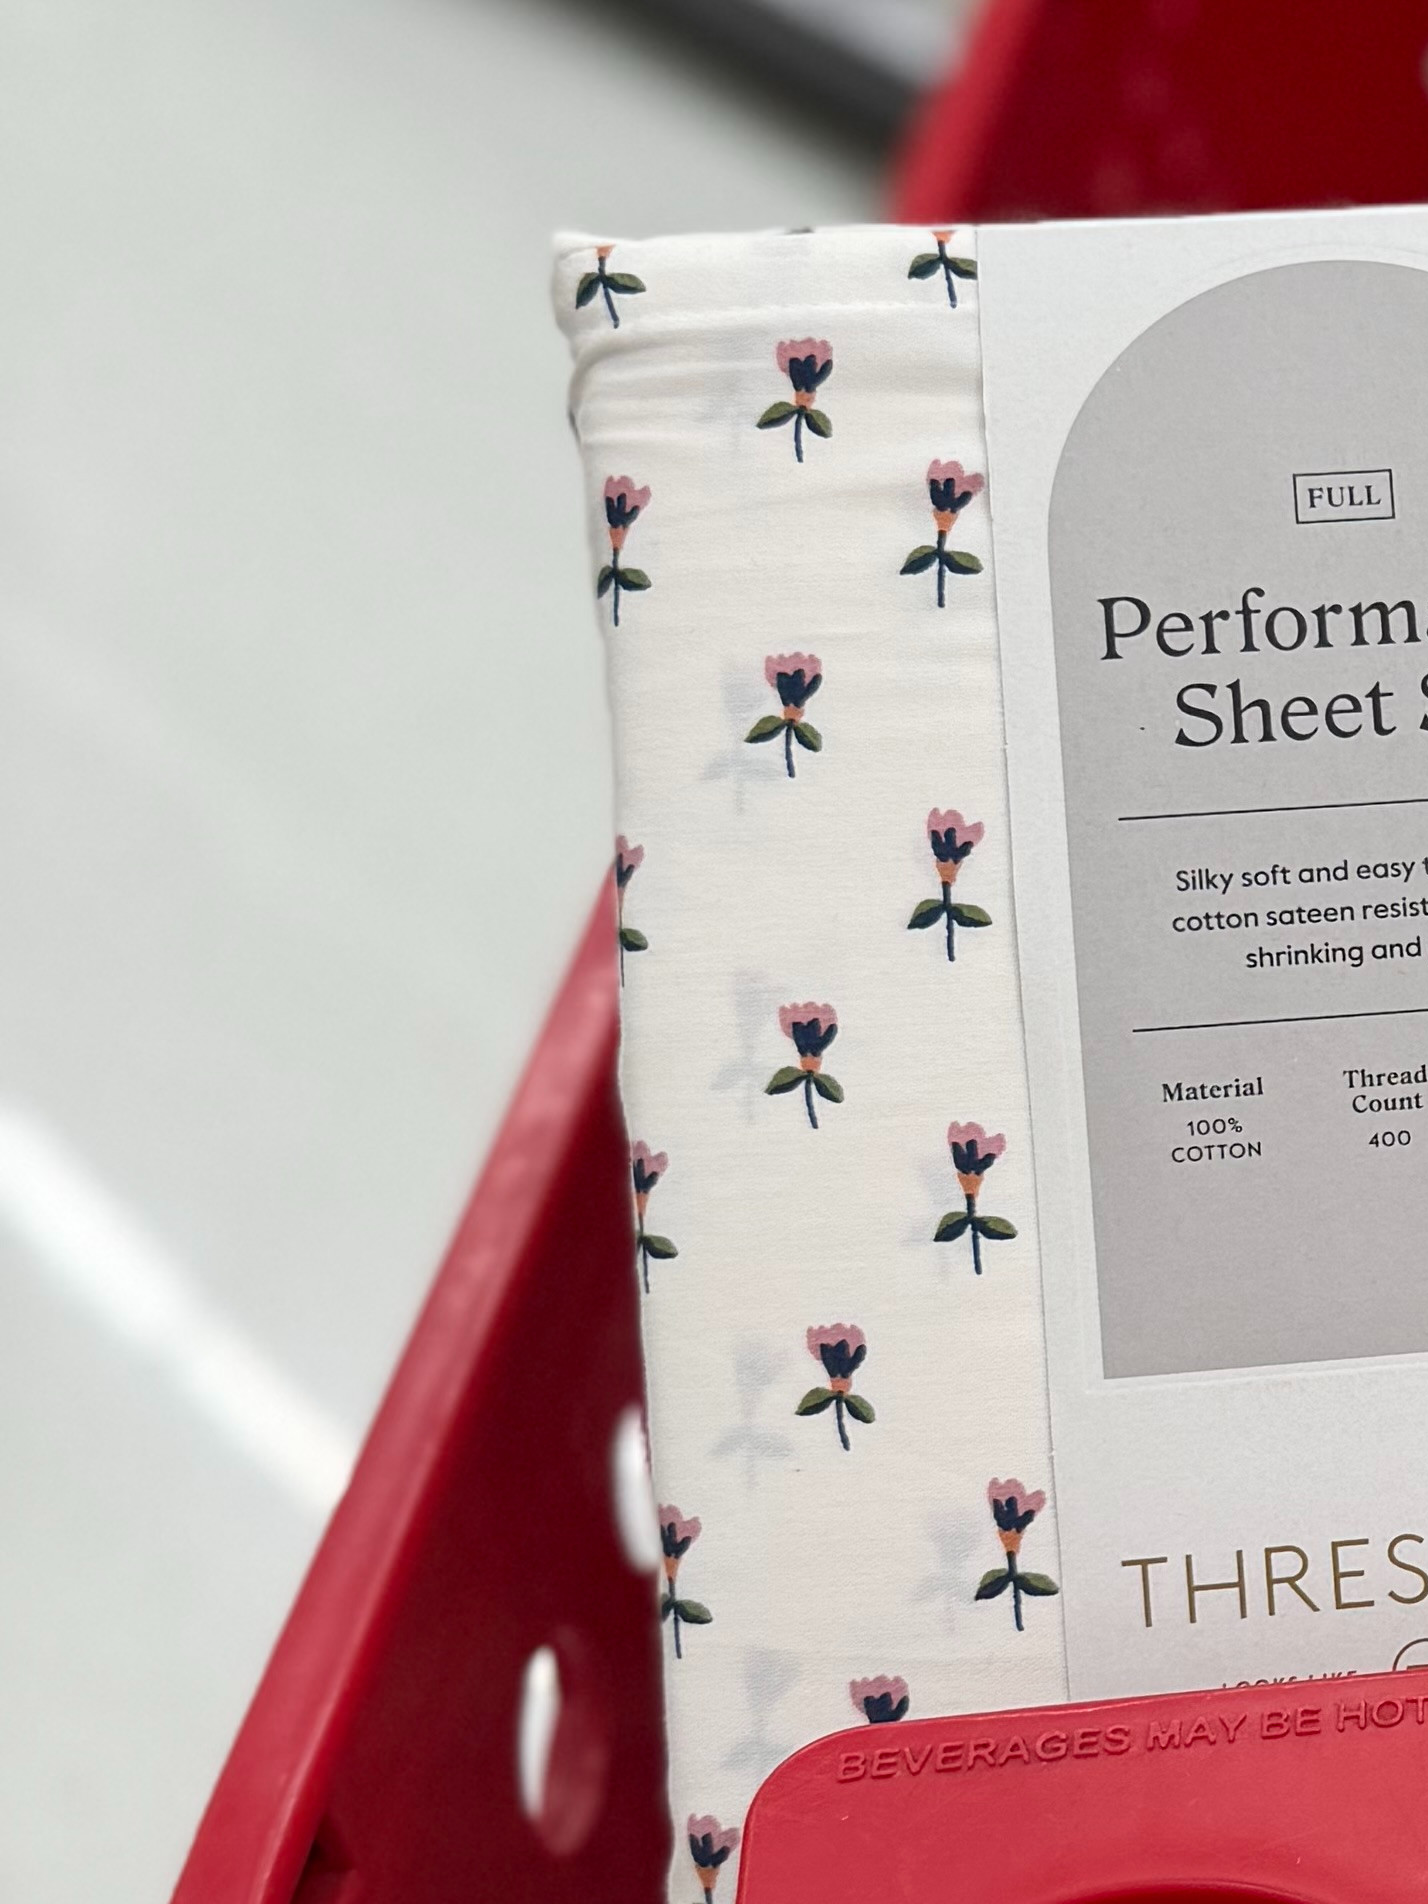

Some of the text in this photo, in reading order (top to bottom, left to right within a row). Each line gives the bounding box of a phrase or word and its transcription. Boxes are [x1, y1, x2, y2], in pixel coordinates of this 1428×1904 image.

[1307, 484, 1382, 509] FULL
[1174, 678, 1397, 748] Sheet
[1175, 868, 1234, 895] Silky
[1241, 863, 1292, 888] soft
[1298, 859, 1349, 884] and
[1356, 861, 1416, 883] easy
[1172, 911, 1259, 933] cotton
[1266, 905, 1355, 927] sateen
[1245, 941, 1364, 969] shrinking
[1371, 935, 1422, 960] and
[1342, 1063, 1428, 1089] Thread
[1162, 1076, 1264, 1103] Material
[1352, 1092, 1424, 1114] Count
[1186, 1117, 1243, 1137] 100%
[1368, 1130, 1412, 1148] 400
[1171, 1141, 1262, 1164] COTTON
[837, 1724, 1131, 1783] BEVERAGES
[1147, 1714, 1247, 1751] MAY
[1261, 1707, 1321, 1741] BE
